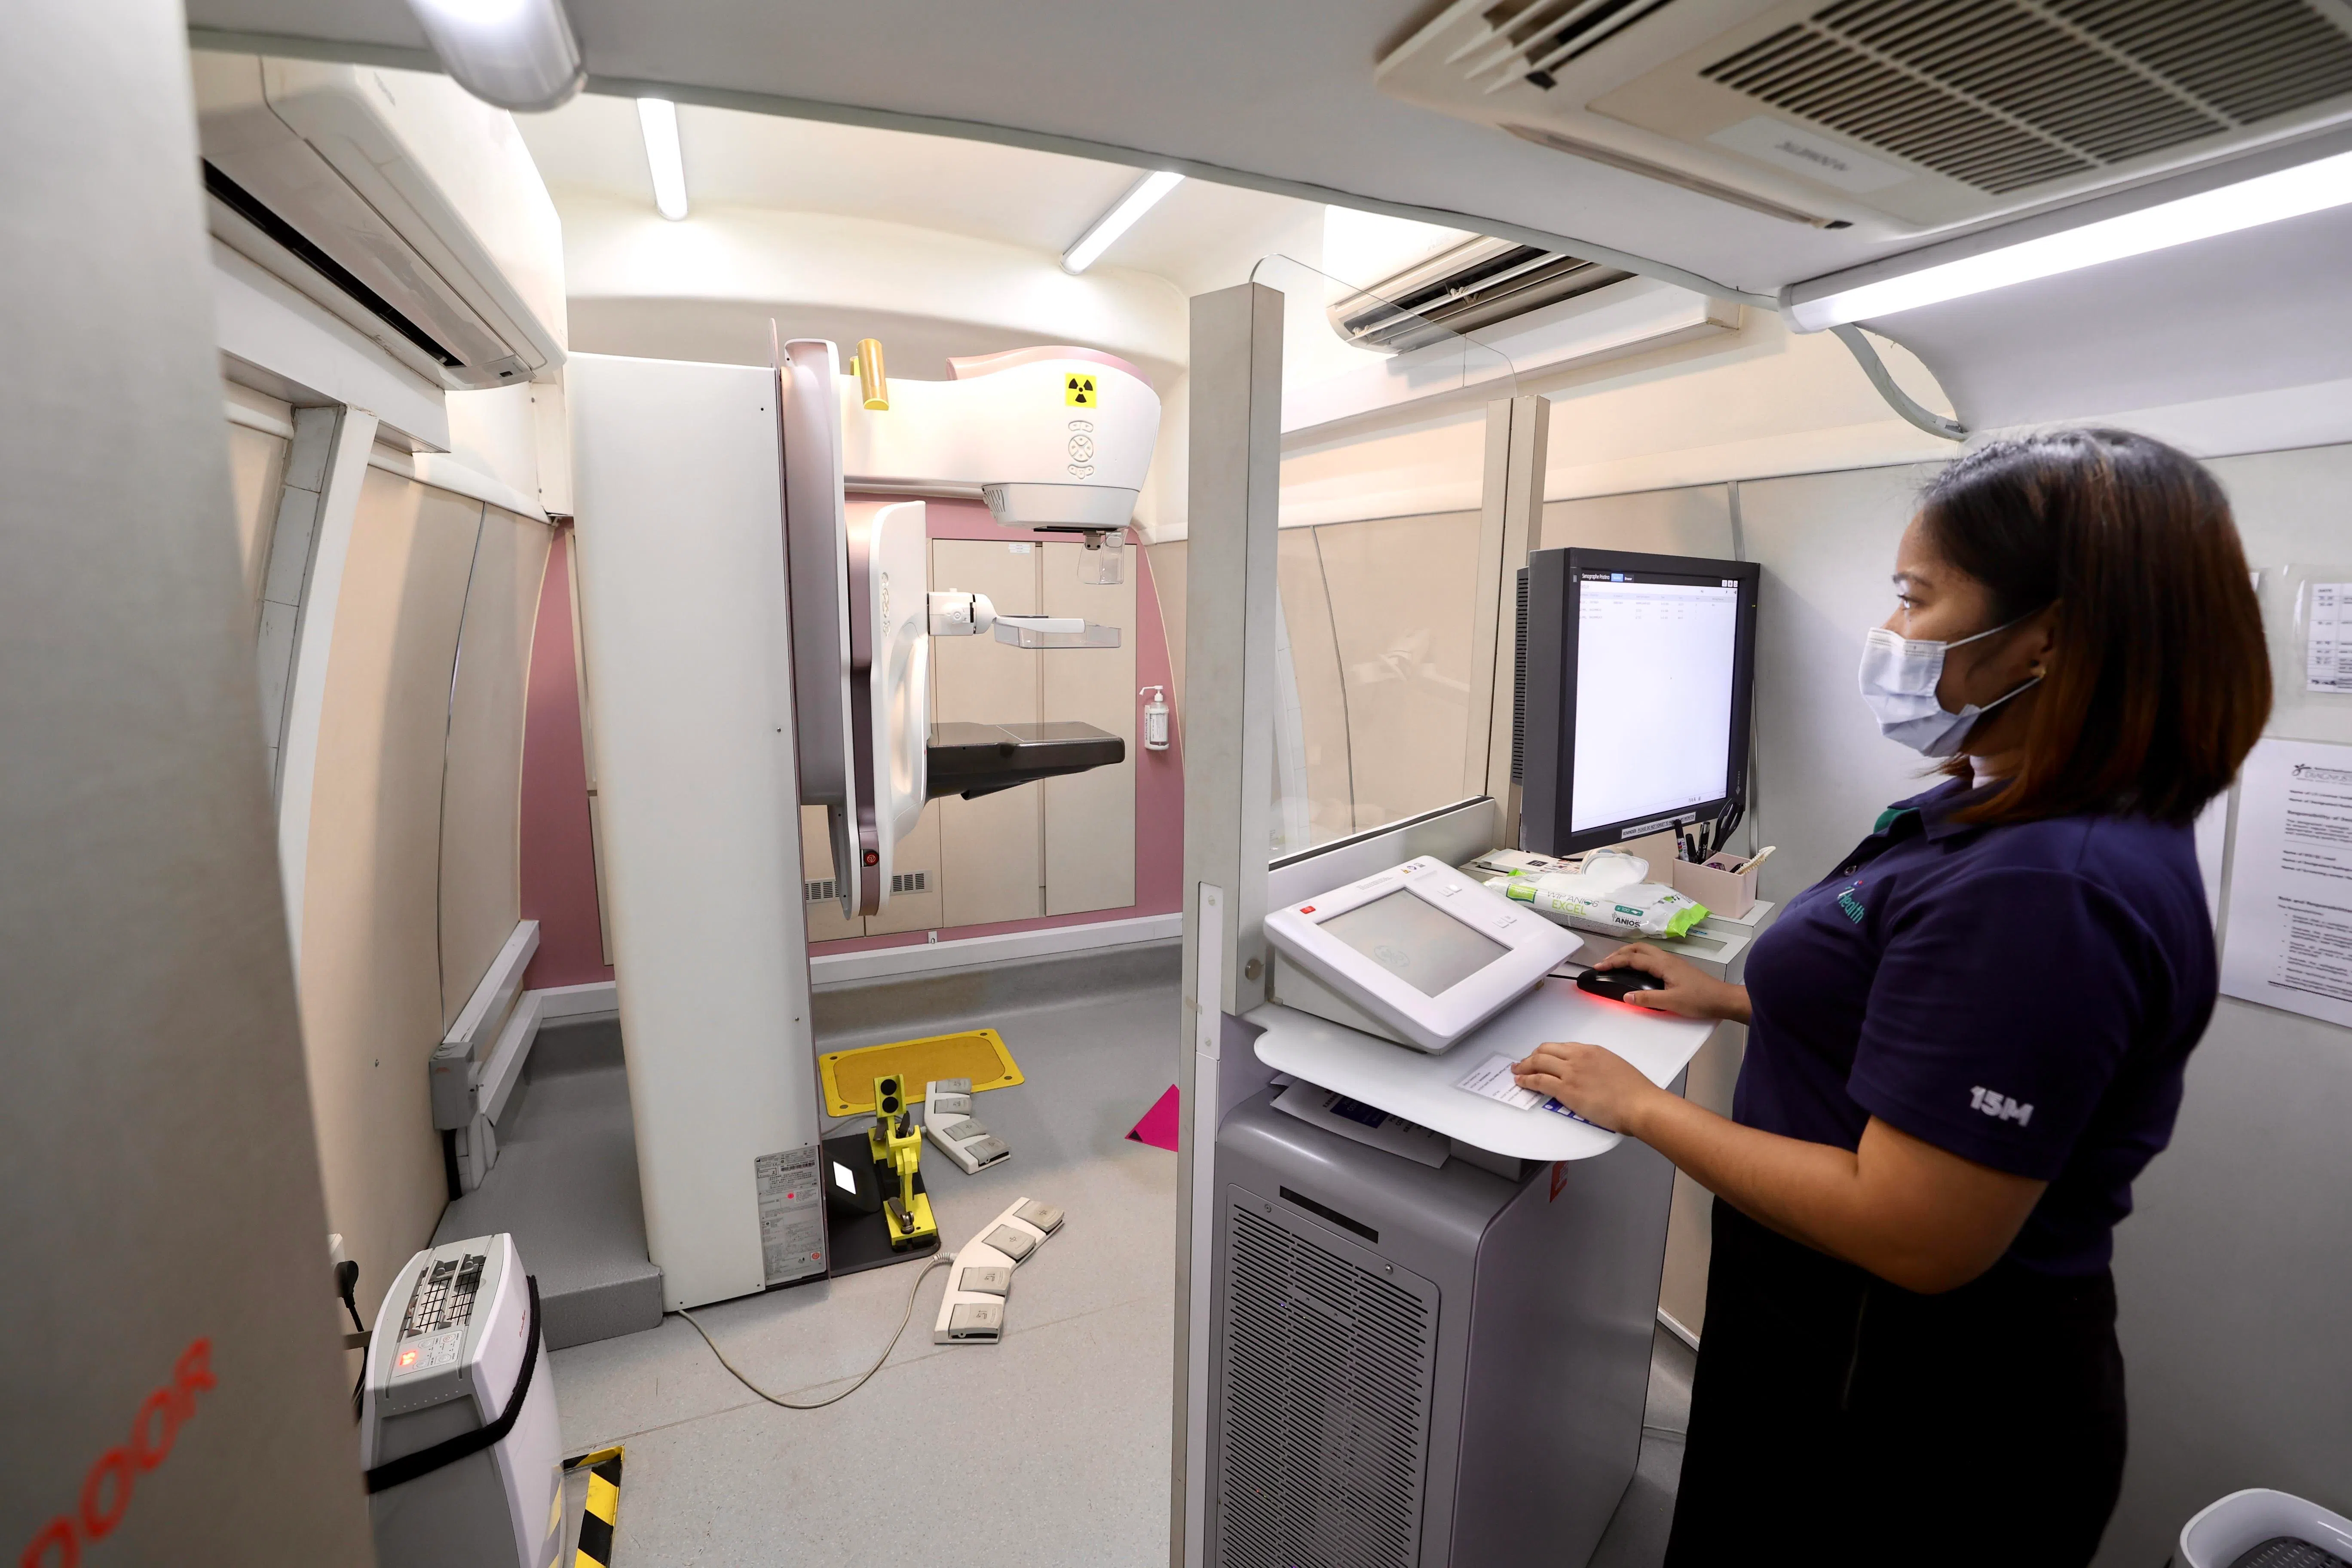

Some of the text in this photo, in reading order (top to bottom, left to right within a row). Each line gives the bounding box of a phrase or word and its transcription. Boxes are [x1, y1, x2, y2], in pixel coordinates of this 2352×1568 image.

[1552, 899, 1586, 916] EXCEL
[1615, 917, 1641, 928] ANIOS
[1969, 1084, 2034, 1128] 15M
